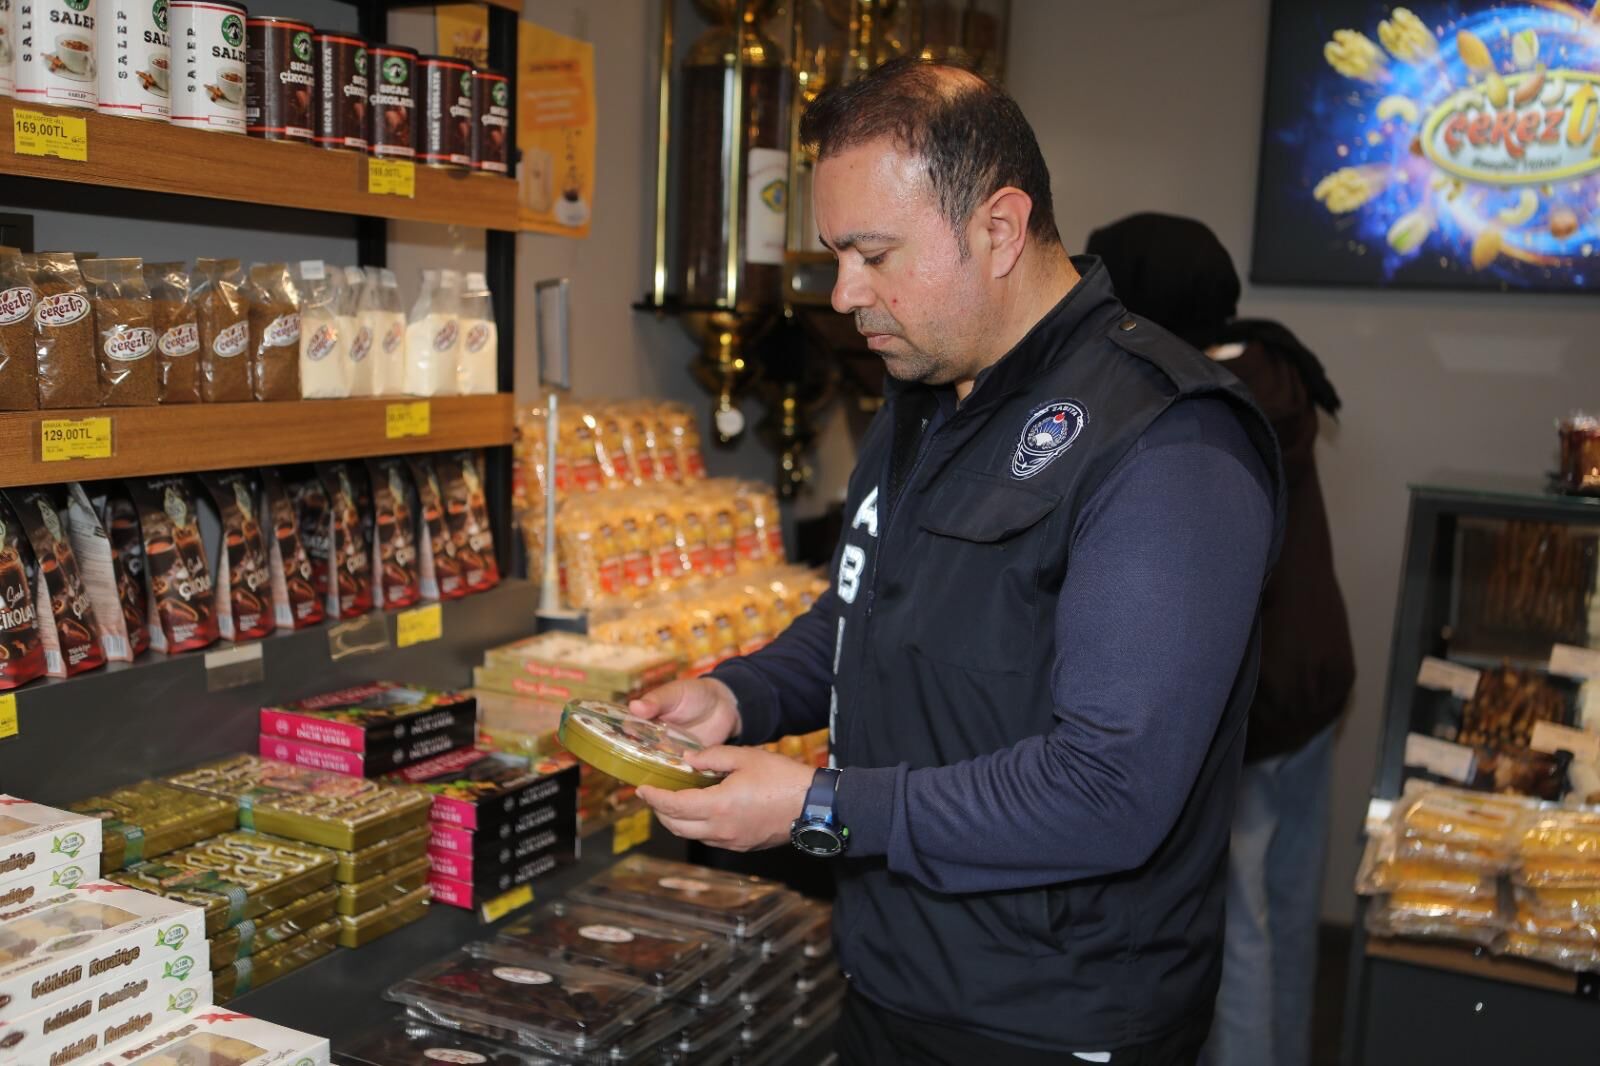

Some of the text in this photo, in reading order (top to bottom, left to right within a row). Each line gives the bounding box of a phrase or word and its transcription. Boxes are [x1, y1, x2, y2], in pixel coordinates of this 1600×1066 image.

[117, 10, 127, 79] SALEP
[187, 27, 197, 93] SALEP
[16, 121, 68, 138] 169,00TL
[1052, 404, 1079, 417] ZABITA
[44, 428, 93, 441] 129,00TL
